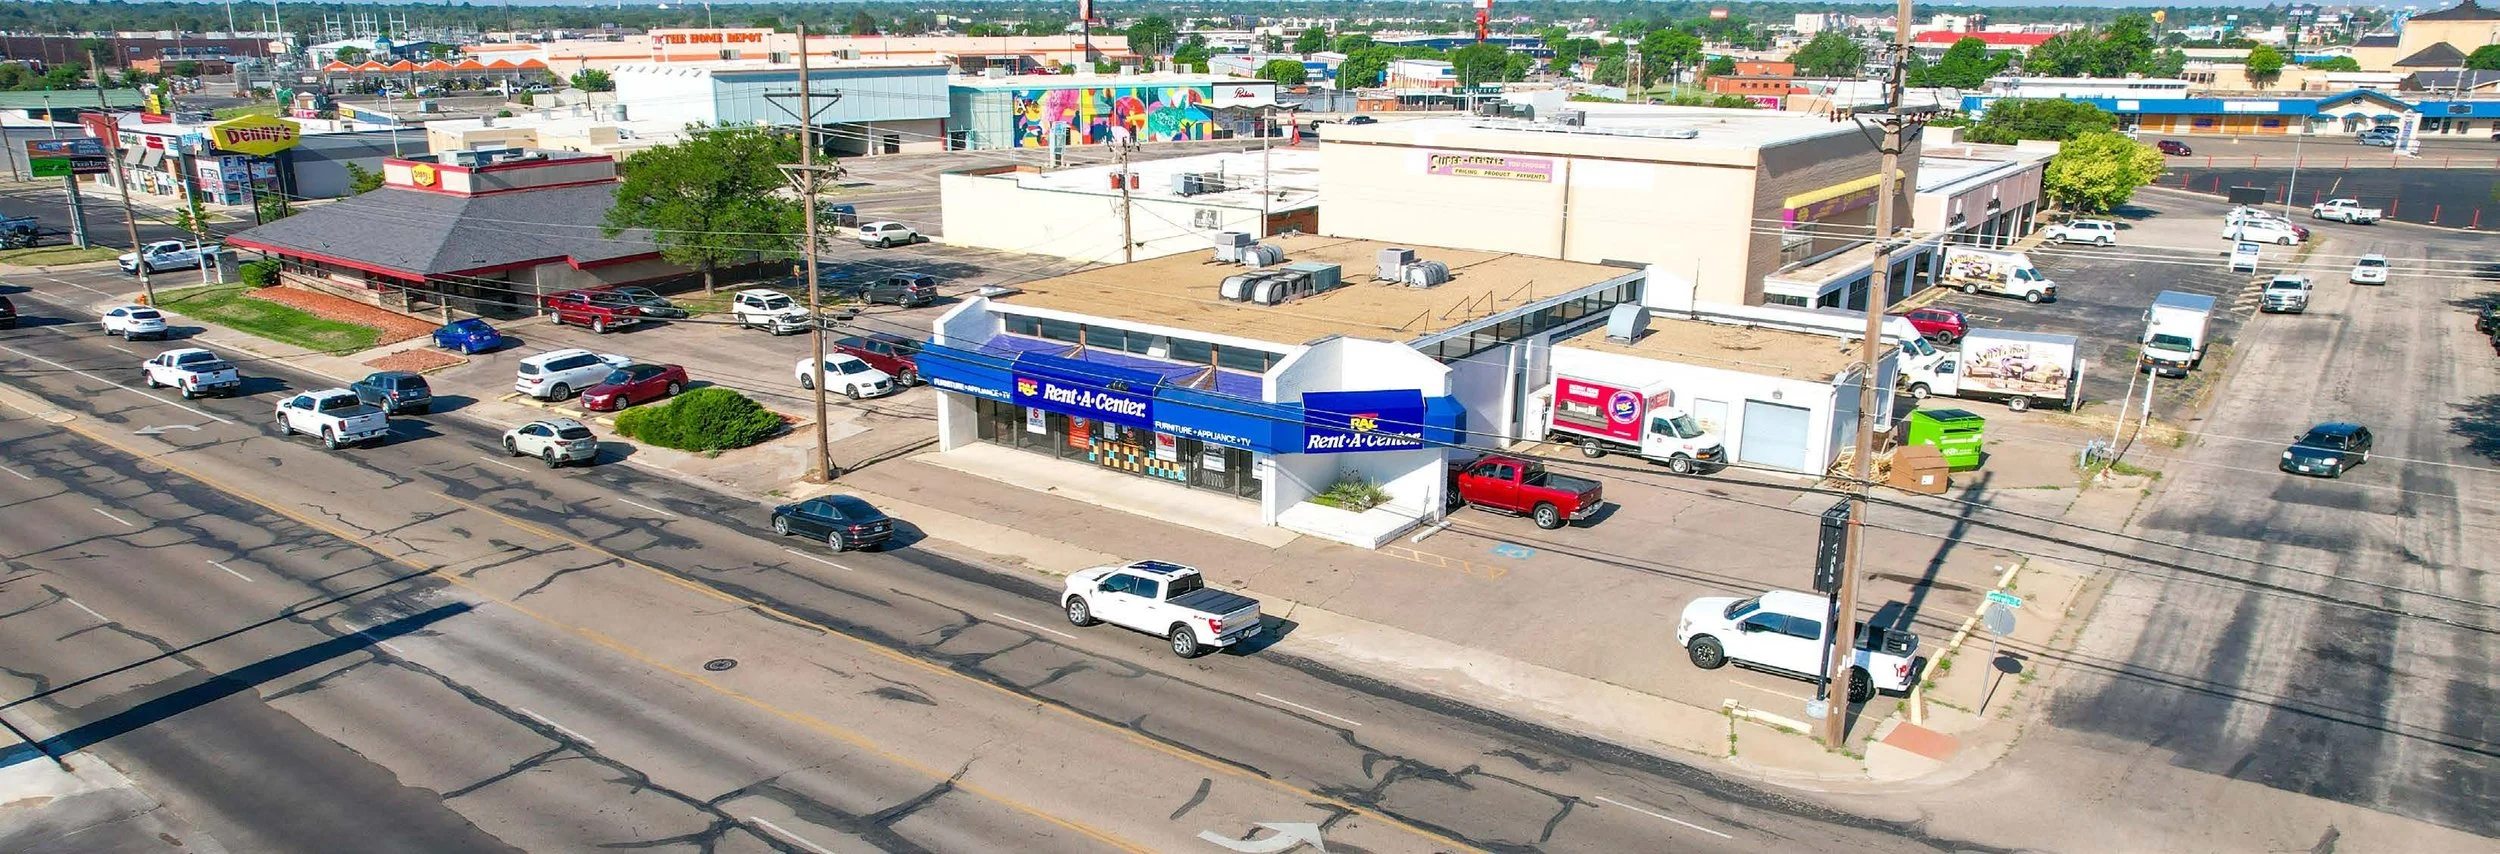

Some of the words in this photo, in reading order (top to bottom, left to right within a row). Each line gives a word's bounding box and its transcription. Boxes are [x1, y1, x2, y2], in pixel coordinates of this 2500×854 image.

[664, 34, 686, 44] THE
[690, 34, 723, 44] HOME
[727, 33, 762, 43] DEPOT
[225, 124, 292, 145] Denny's
[933, 377, 965, 390] FURNITURE
[1002, 390, 1011, 399] TV
[1018, 381, 1038, 397] RAC
[1032, 408, 1039, 419] 6
[1350, 418, 1378, 432] RAC
[1154, 420, 1193, 435] FURNITURE
[1197, 429, 1236, 444] APPLIANCE
[1241, 438, 1251, 447] TV
